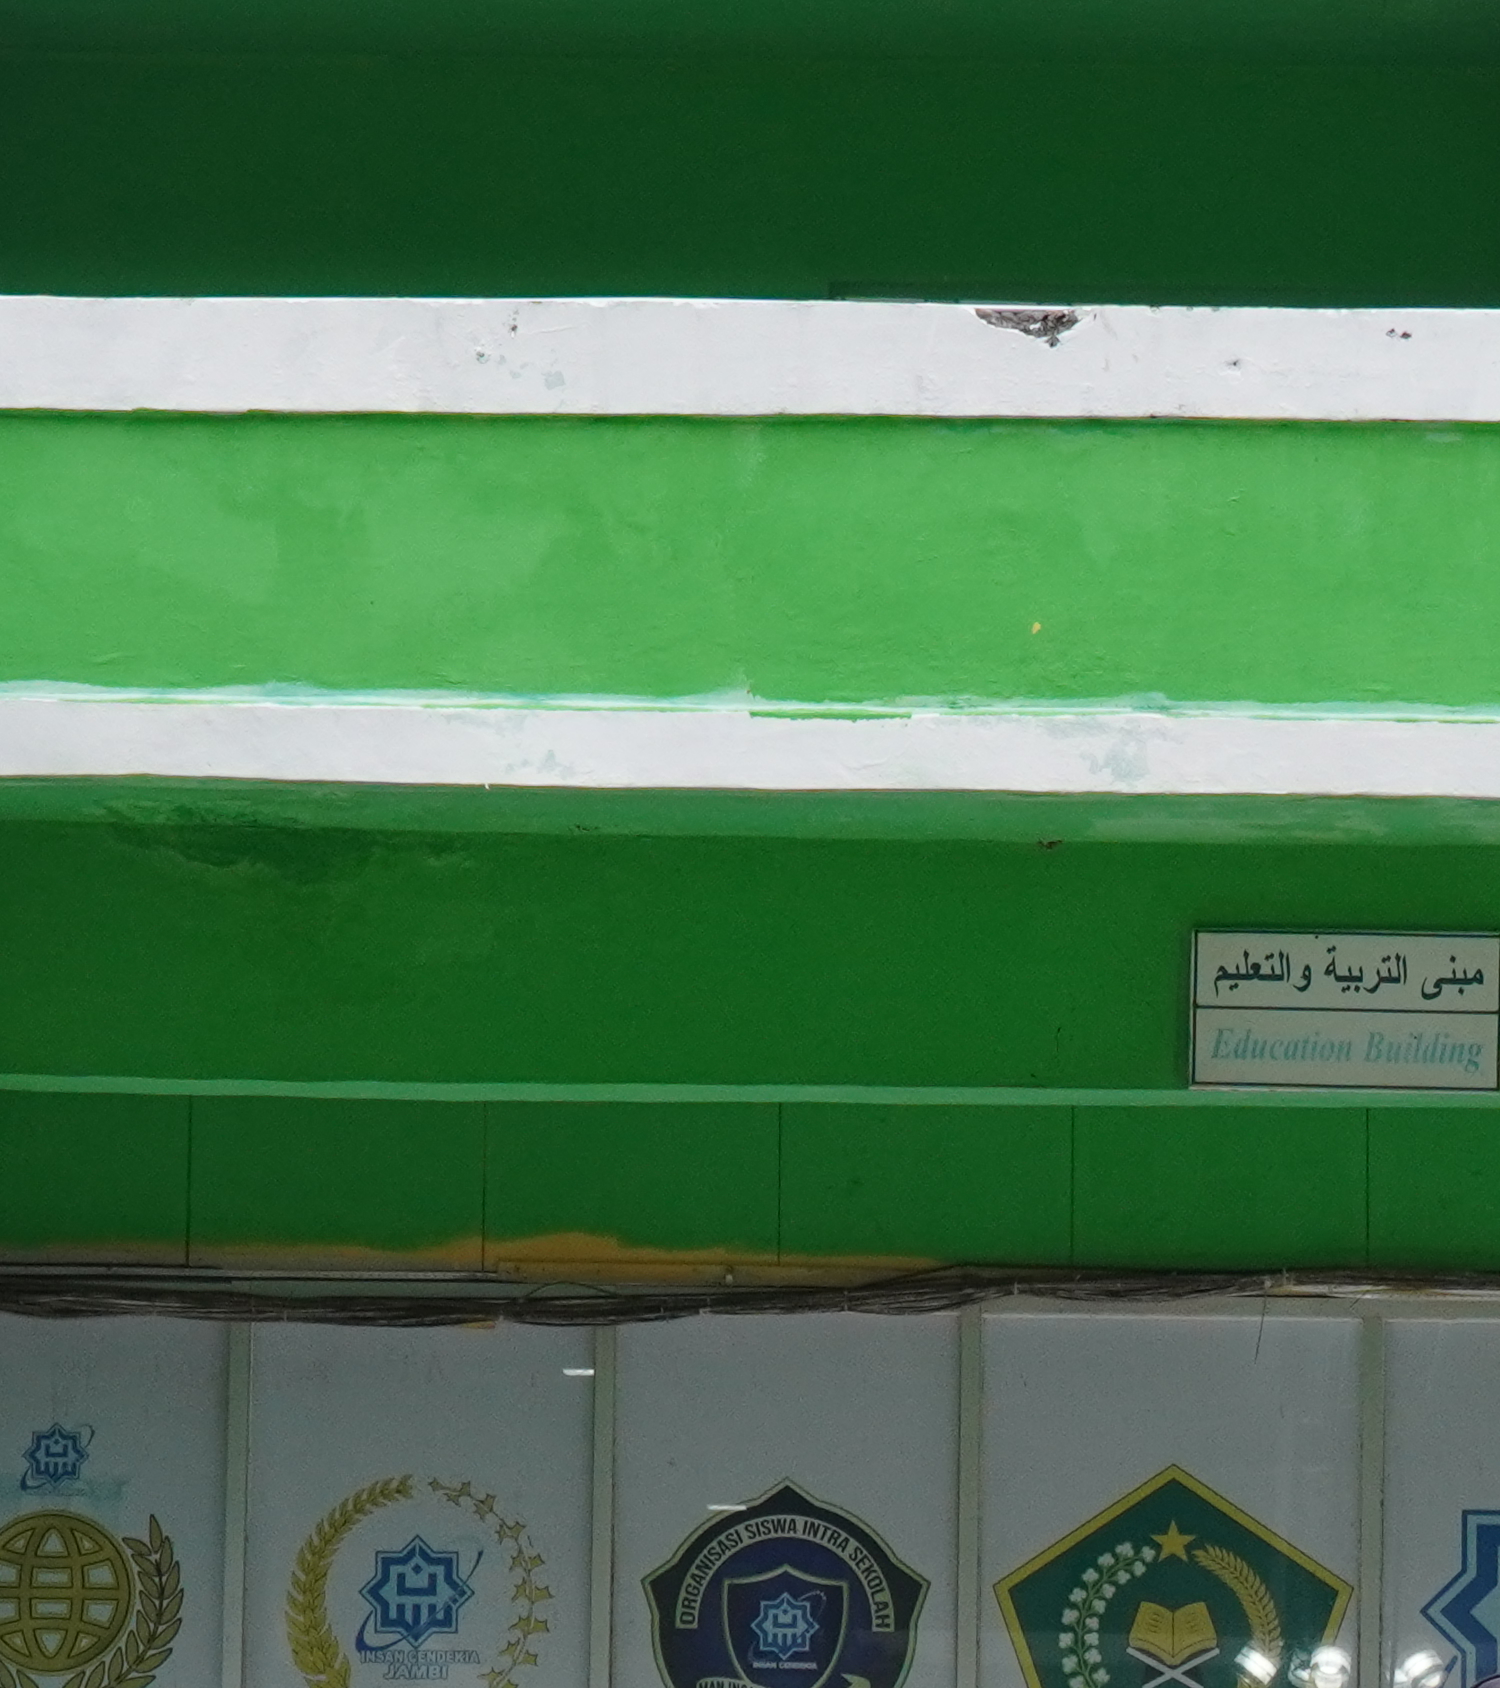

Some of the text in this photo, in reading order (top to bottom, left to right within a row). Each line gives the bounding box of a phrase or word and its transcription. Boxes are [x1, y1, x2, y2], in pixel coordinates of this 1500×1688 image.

[1323, 945, 1407, 994] التربية
[1421, 955, 1484, 1000] مبنى
[1211, 1028, 1484, 1075] Education Building
[679, 1517, 891, 1630] ORGANISASI SISWA INTRA SEKOLAH
[359, 1650, 480, 1664] INSAN CENDEKIA
[383, 1664, 449, 1680] JAMBI
